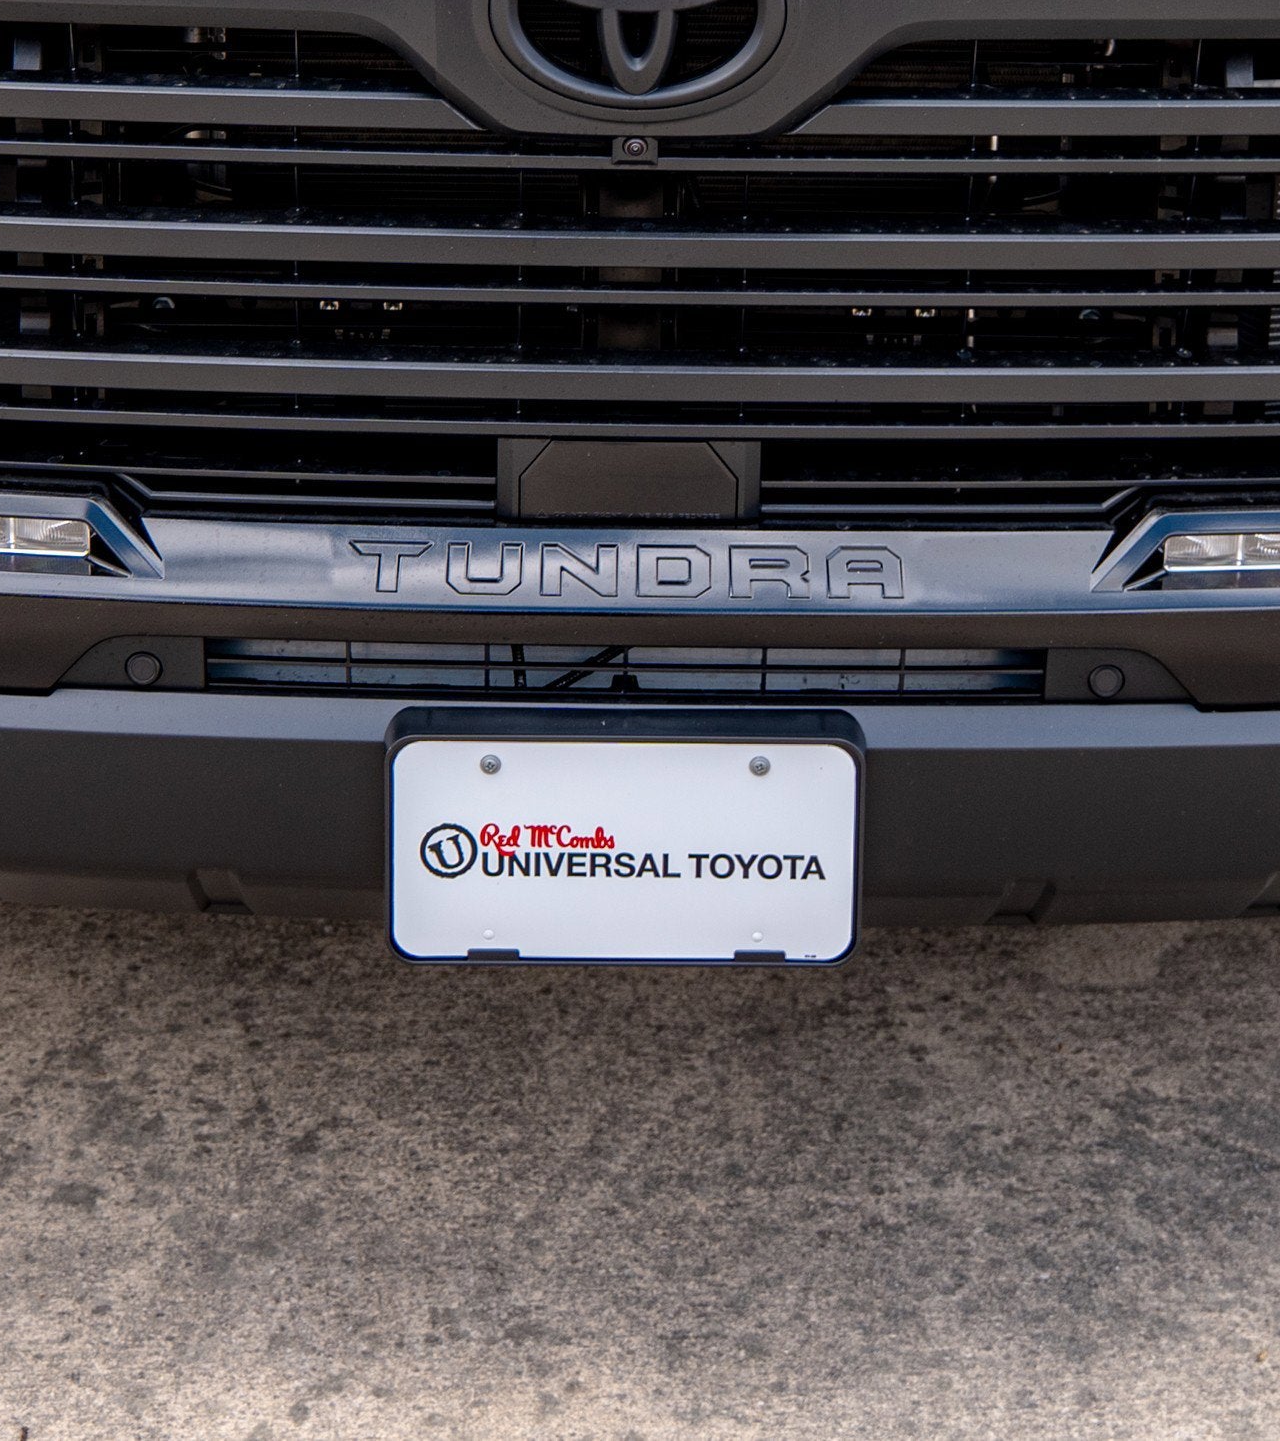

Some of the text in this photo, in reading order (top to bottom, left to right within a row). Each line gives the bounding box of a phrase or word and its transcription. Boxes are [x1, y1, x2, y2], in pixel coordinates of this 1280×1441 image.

[348, 539, 905, 600] TUNDRA
[480, 823, 615, 856] Red McCombs
[481, 851, 826, 880] UNIVERSAL TOYOTA
